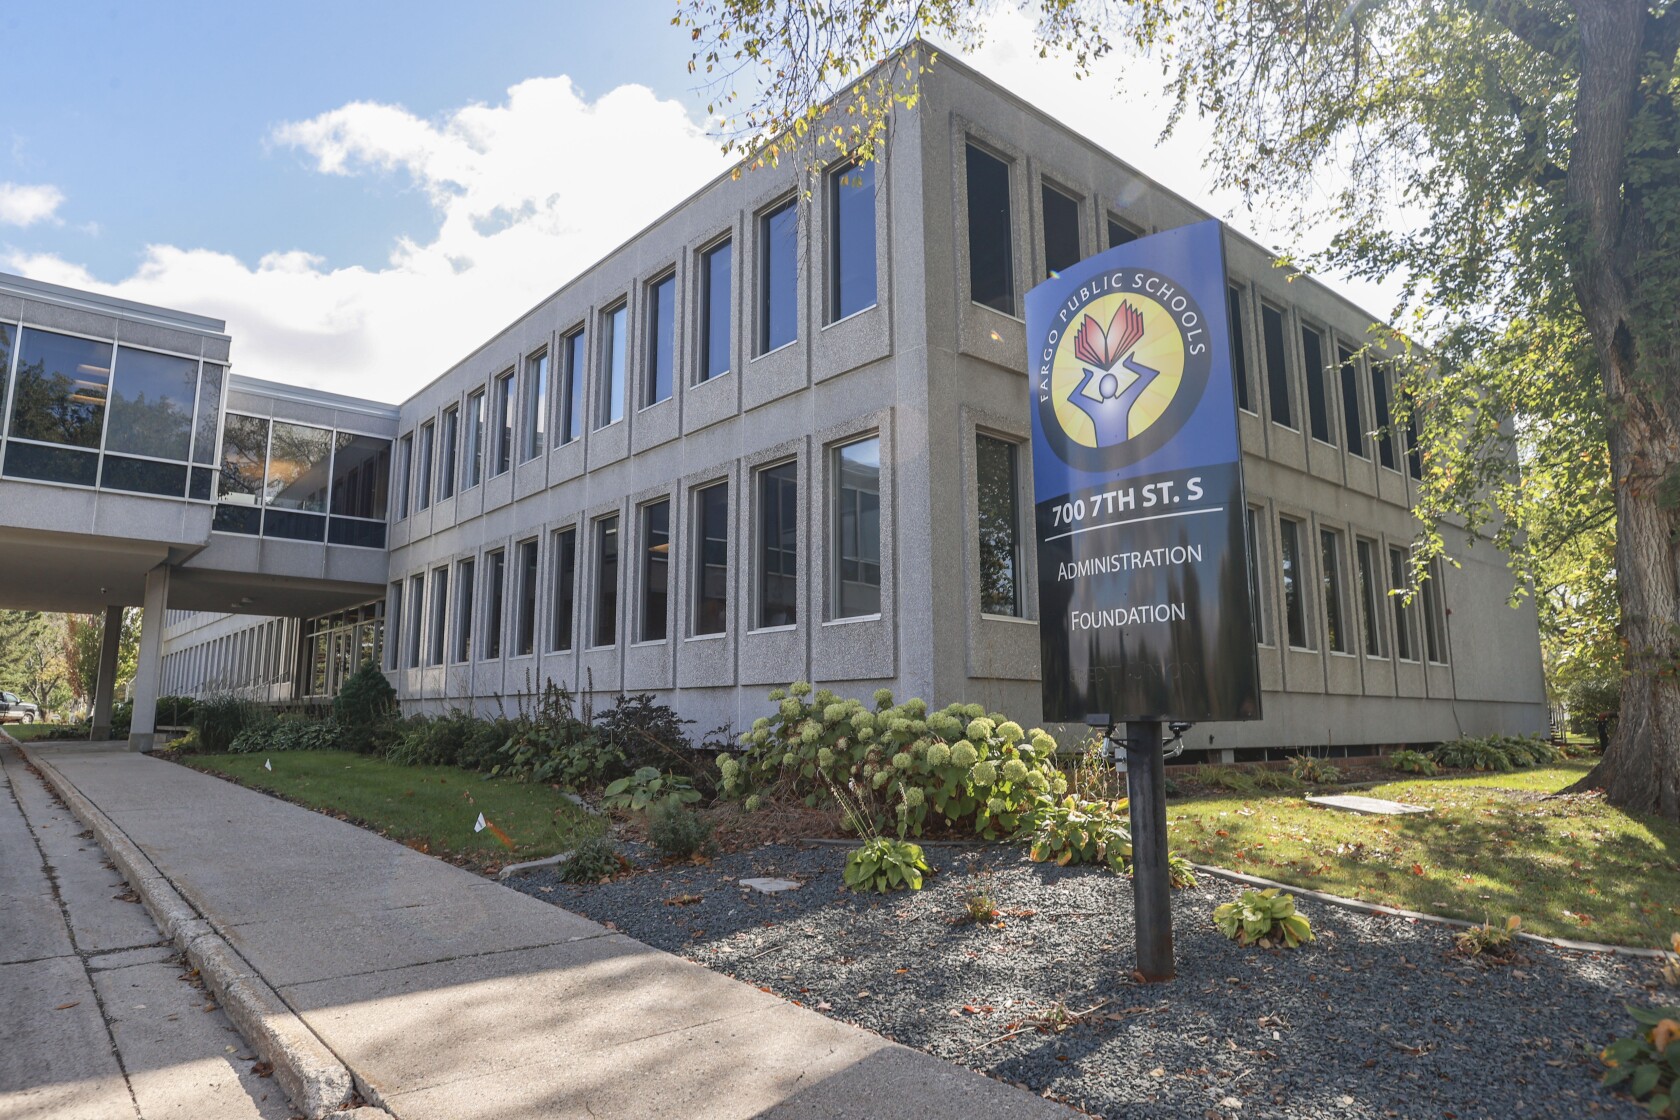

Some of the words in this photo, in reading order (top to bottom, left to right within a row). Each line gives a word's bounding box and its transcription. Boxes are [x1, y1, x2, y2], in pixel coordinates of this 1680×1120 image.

[1040, 329, 1059, 403] FARGO
[1059, 272, 1123, 323] PUBLIC
[1132, 273, 1206, 356] SCHOOLS
[1052, 499, 1086, 527] 700
[1089, 487, 1136, 518] 7TH
[1142, 480, 1180, 508] ST.
[1187, 477, 1204, 501] S
[1057, 544, 1203, 582] ADMINISTRATION
[1071, 602, 1186, 631] FOUNDATION
